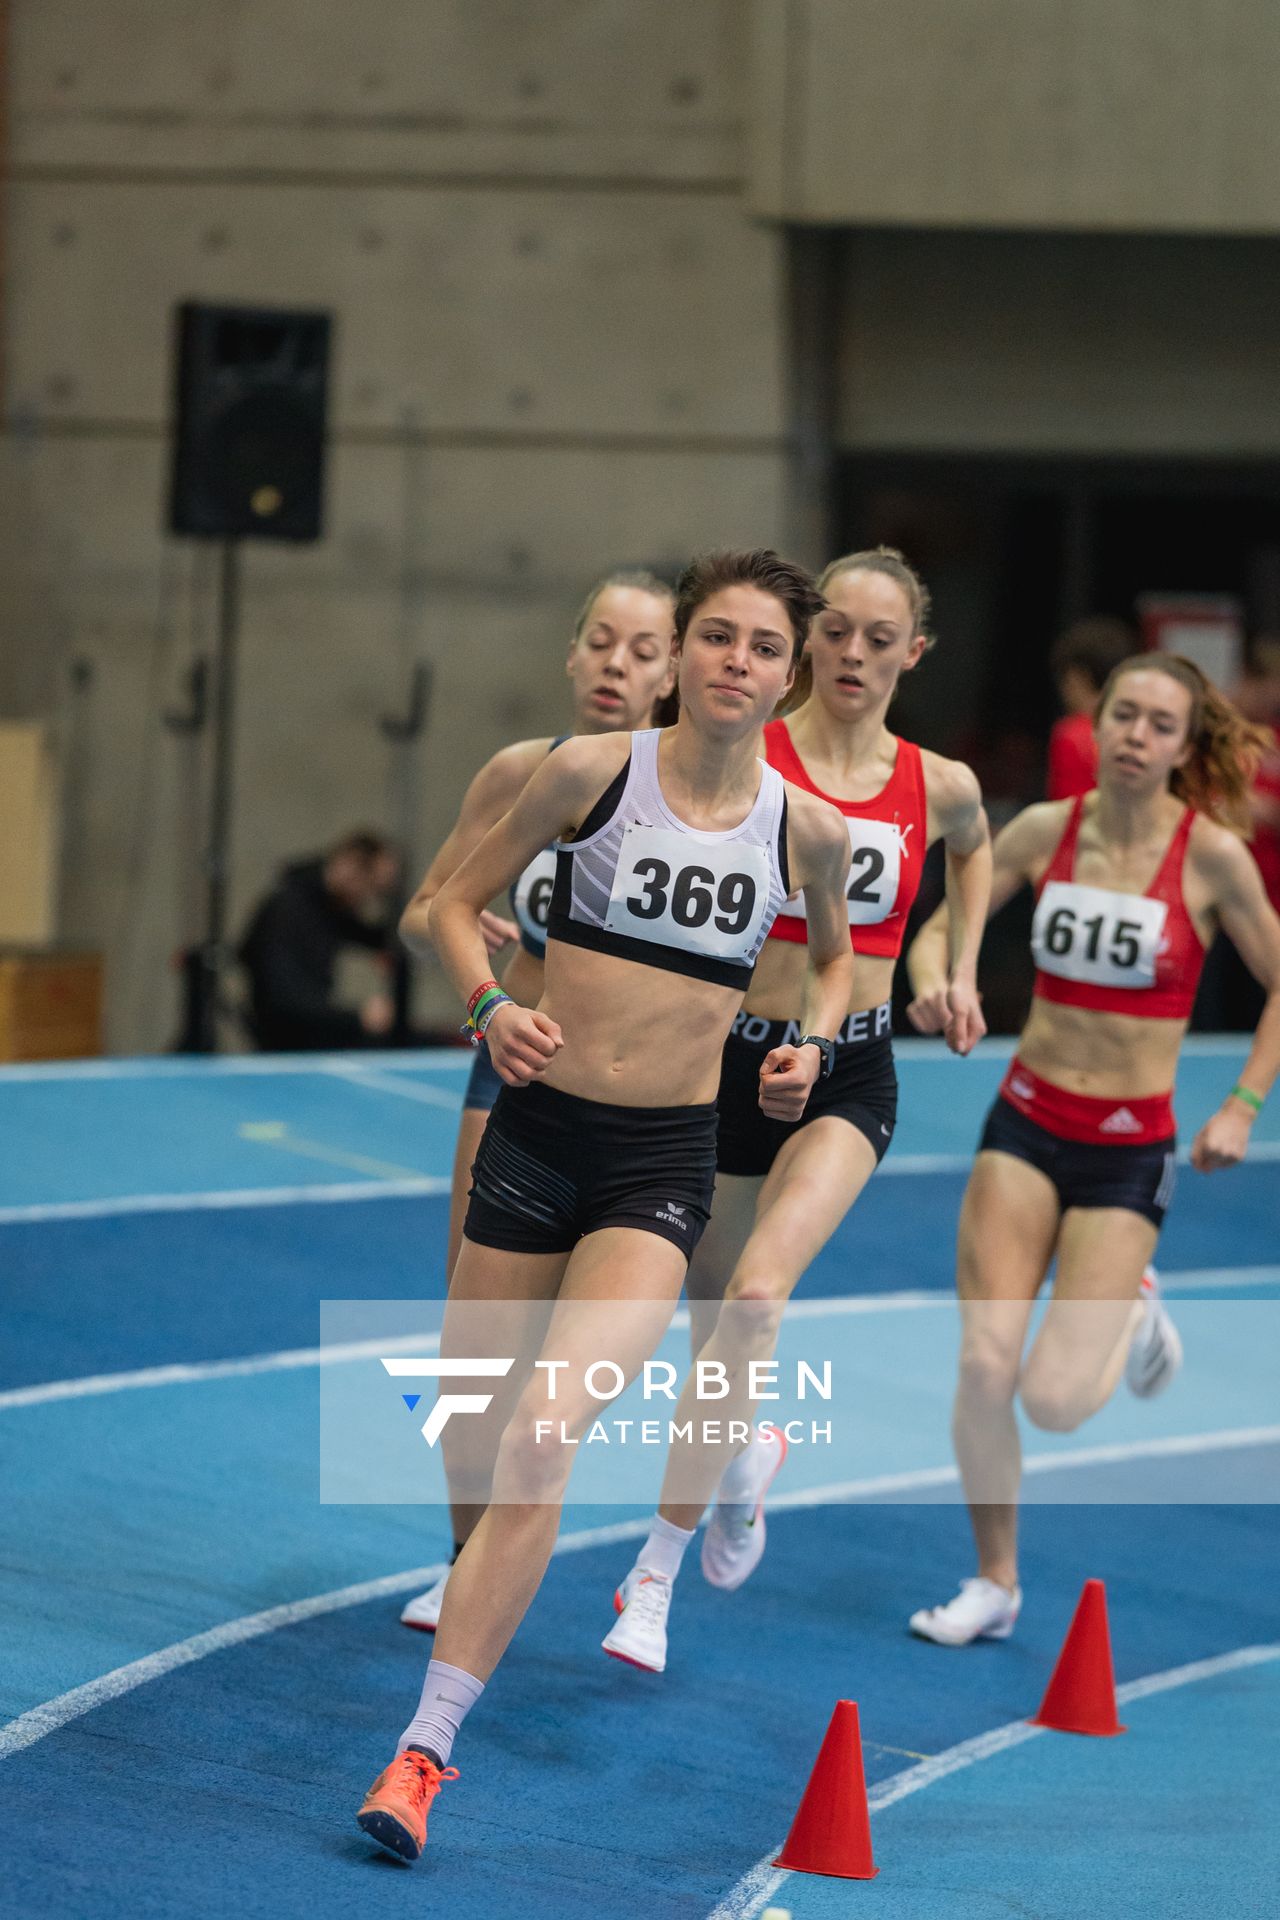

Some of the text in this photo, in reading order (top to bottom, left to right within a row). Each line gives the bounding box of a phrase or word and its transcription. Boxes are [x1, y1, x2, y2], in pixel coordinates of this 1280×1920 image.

[626, 857, 756, 935] 369
[1045, 908, 1143, 969] 615
[655, 1210, 687, 1231] erima
